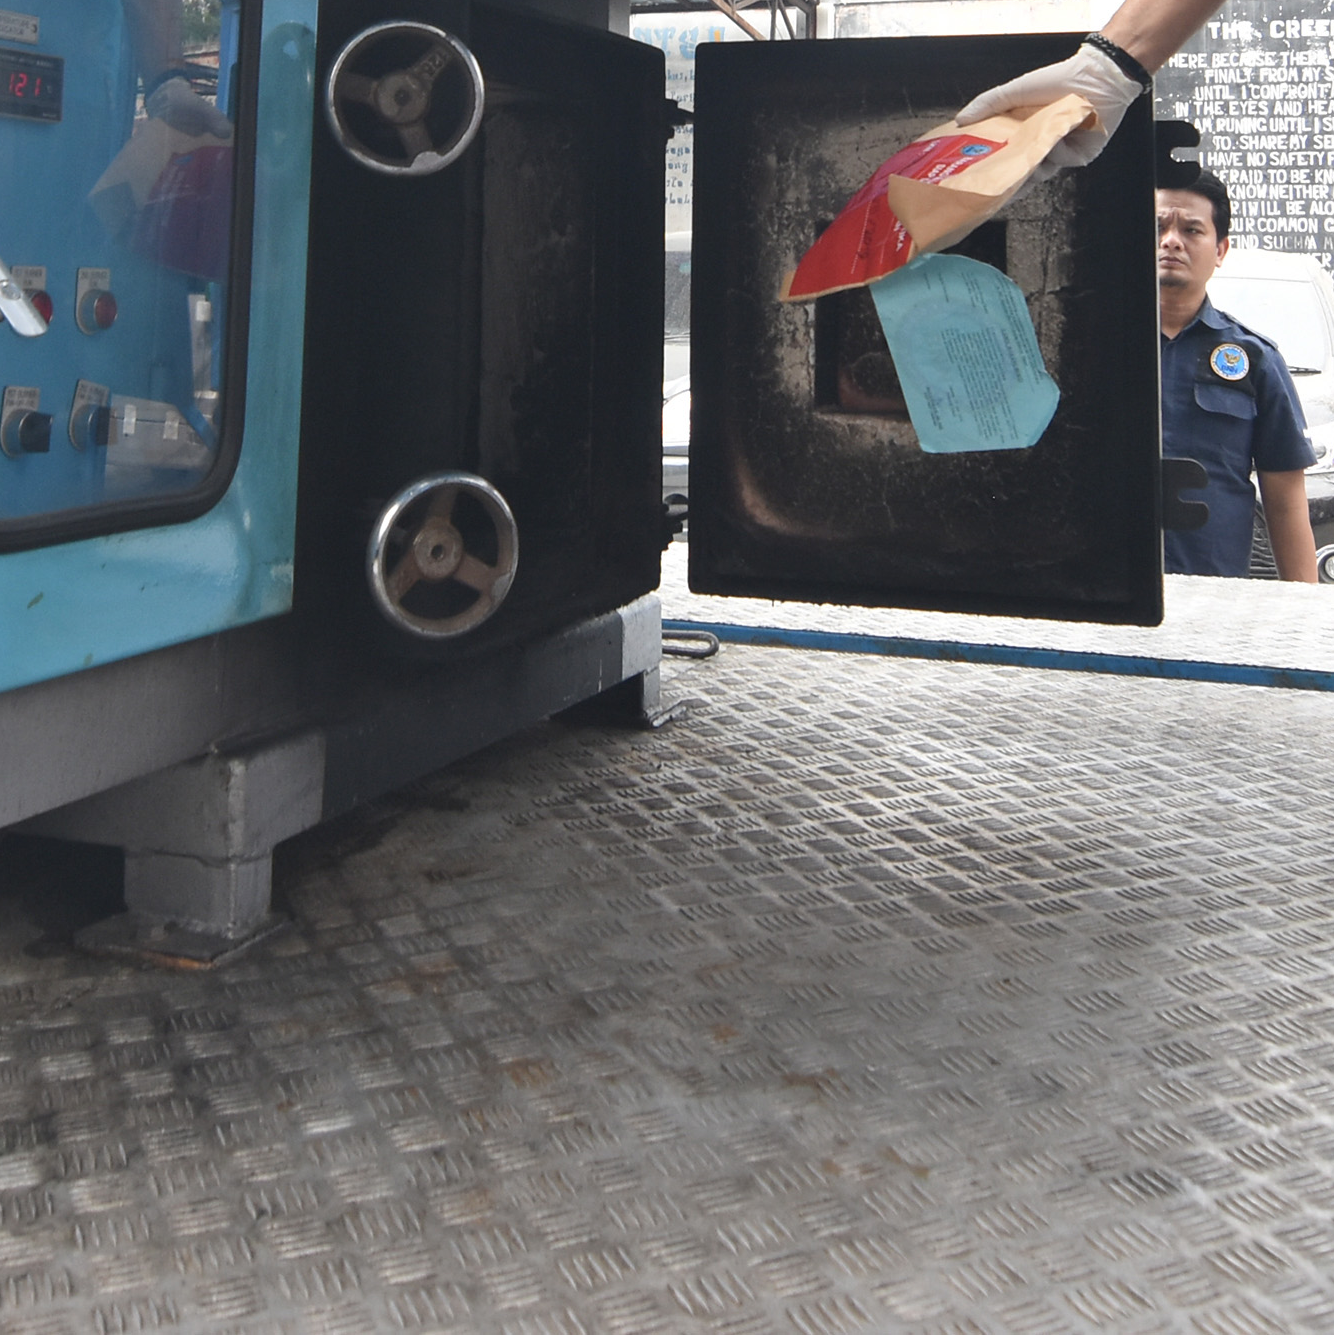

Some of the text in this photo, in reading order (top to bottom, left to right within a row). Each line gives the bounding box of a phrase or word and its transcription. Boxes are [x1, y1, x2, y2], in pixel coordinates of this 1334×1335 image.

[1169, 53, 1208, 68] HERE
[1212, 51, 1276, 68] BECAUSE
[1205, 68, 1253, 84] FINALY
[1260, 68, 1299, 82] FROM
[1302, 66, 1322, 82] MY
[9, 72, 42, 97] 121
[1194, 85, 1236, 101] UNTIL
[1175, 102, 1190, 118] IN
[1193, 101, 1225, 116] THE
[1228, 101, 1269, 116] EYES
[1273, 100, 1303, 116] AND
[1193, 118, 1213, 134] AM
[1269, 117, 1312, 134] UNTIL
[1239, 134, 1288, 151] SHARE
[1289, 135, 1308, 151] MY
[1207, 151, 1243, 167] HAVE
[1246, 151, 1267, 167] NO
[1269, 150, 1325, 167] SAFETY
[1267, 168, 1288, 184] TO
[1290, 168, 1311, 184] BE
[1268, 184, 1329, 201] NEITHER
[1247, 201, 1281, 217] WILL
[1286, 200, 1306, 216] BE
[1257, 217, 1319, 234] COMMON
[1229, 234, 1260, 251] FIND
